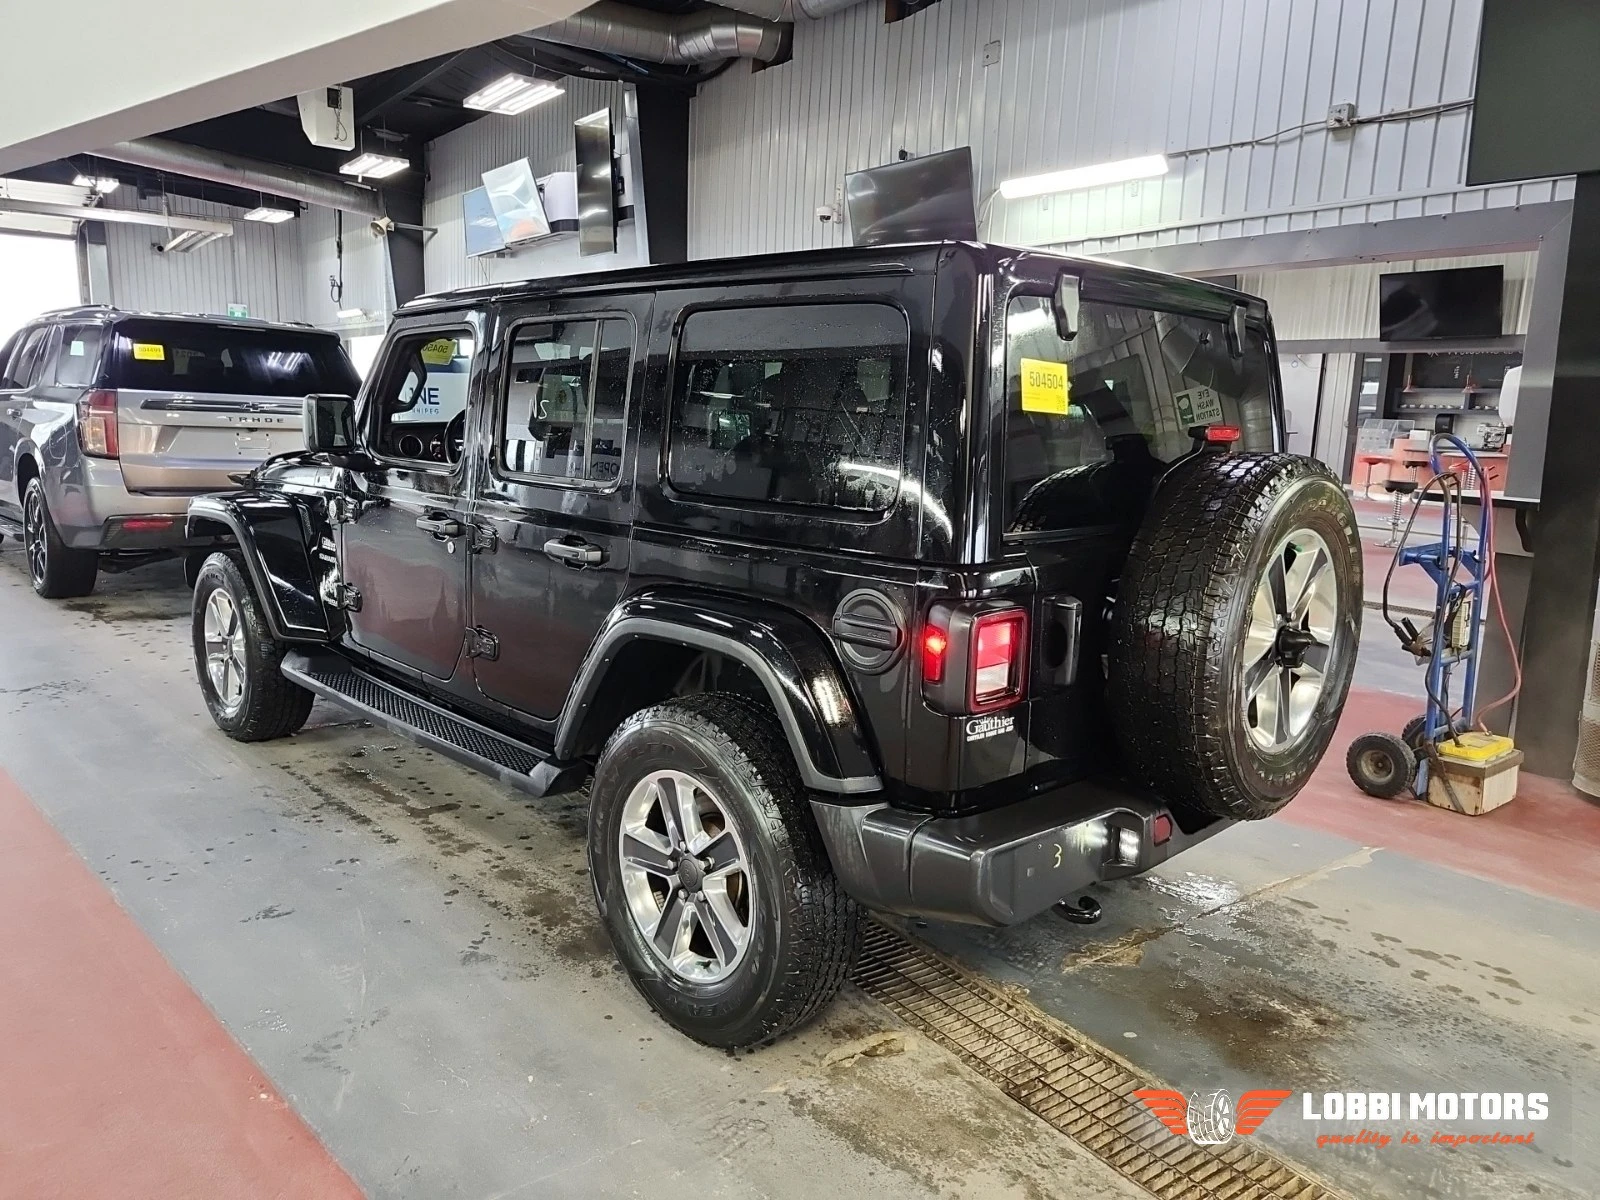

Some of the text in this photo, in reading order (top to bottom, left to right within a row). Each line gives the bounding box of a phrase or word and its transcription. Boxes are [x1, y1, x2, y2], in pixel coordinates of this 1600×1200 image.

[1029, 371, 1063, 390] 504504
[966, 716, 1015, 735] Gauthier
[1053, 843, 1062, 868] 3
